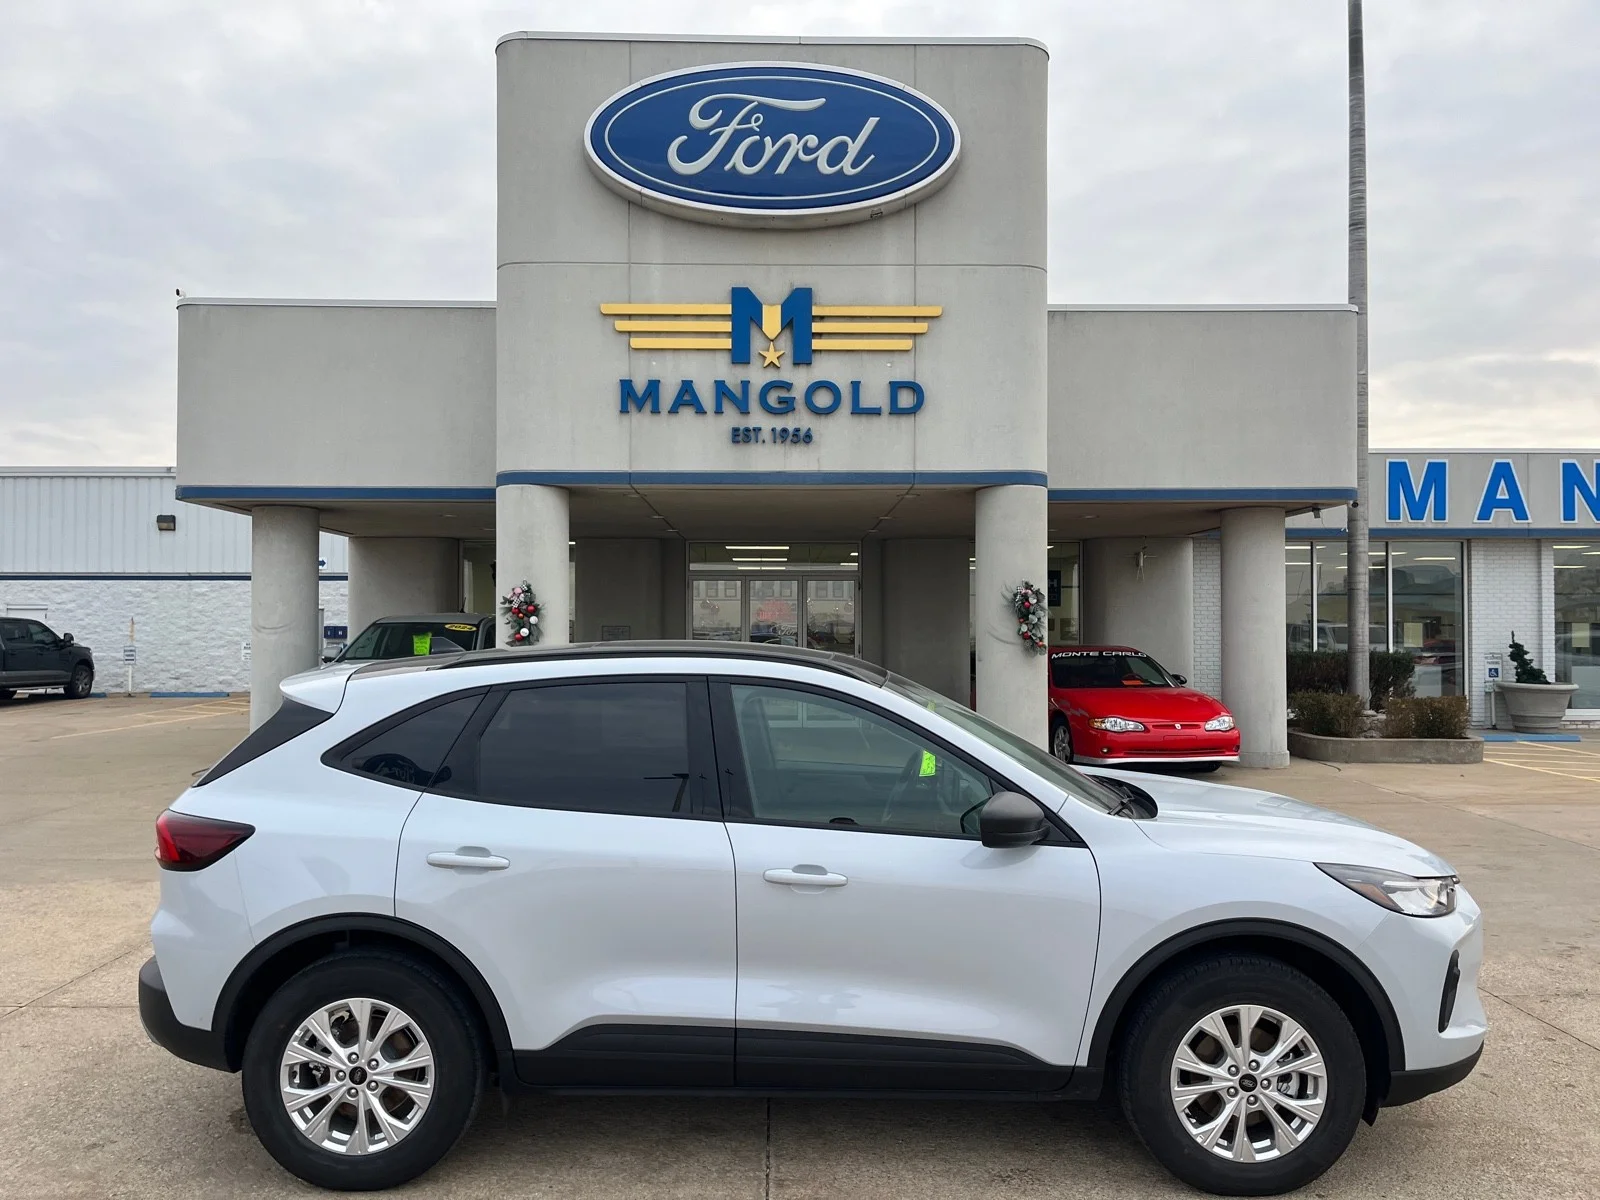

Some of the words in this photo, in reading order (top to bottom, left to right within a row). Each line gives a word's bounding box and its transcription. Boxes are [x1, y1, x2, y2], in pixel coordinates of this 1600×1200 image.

[667, 93, 880, 176] Ford
[619, 379, 926, 416] MANGOLD
[731, 427, 766, 443] EST.
[771, 427, 814, 443] 1956
[1051, 651, 1100, 659] MONTE
